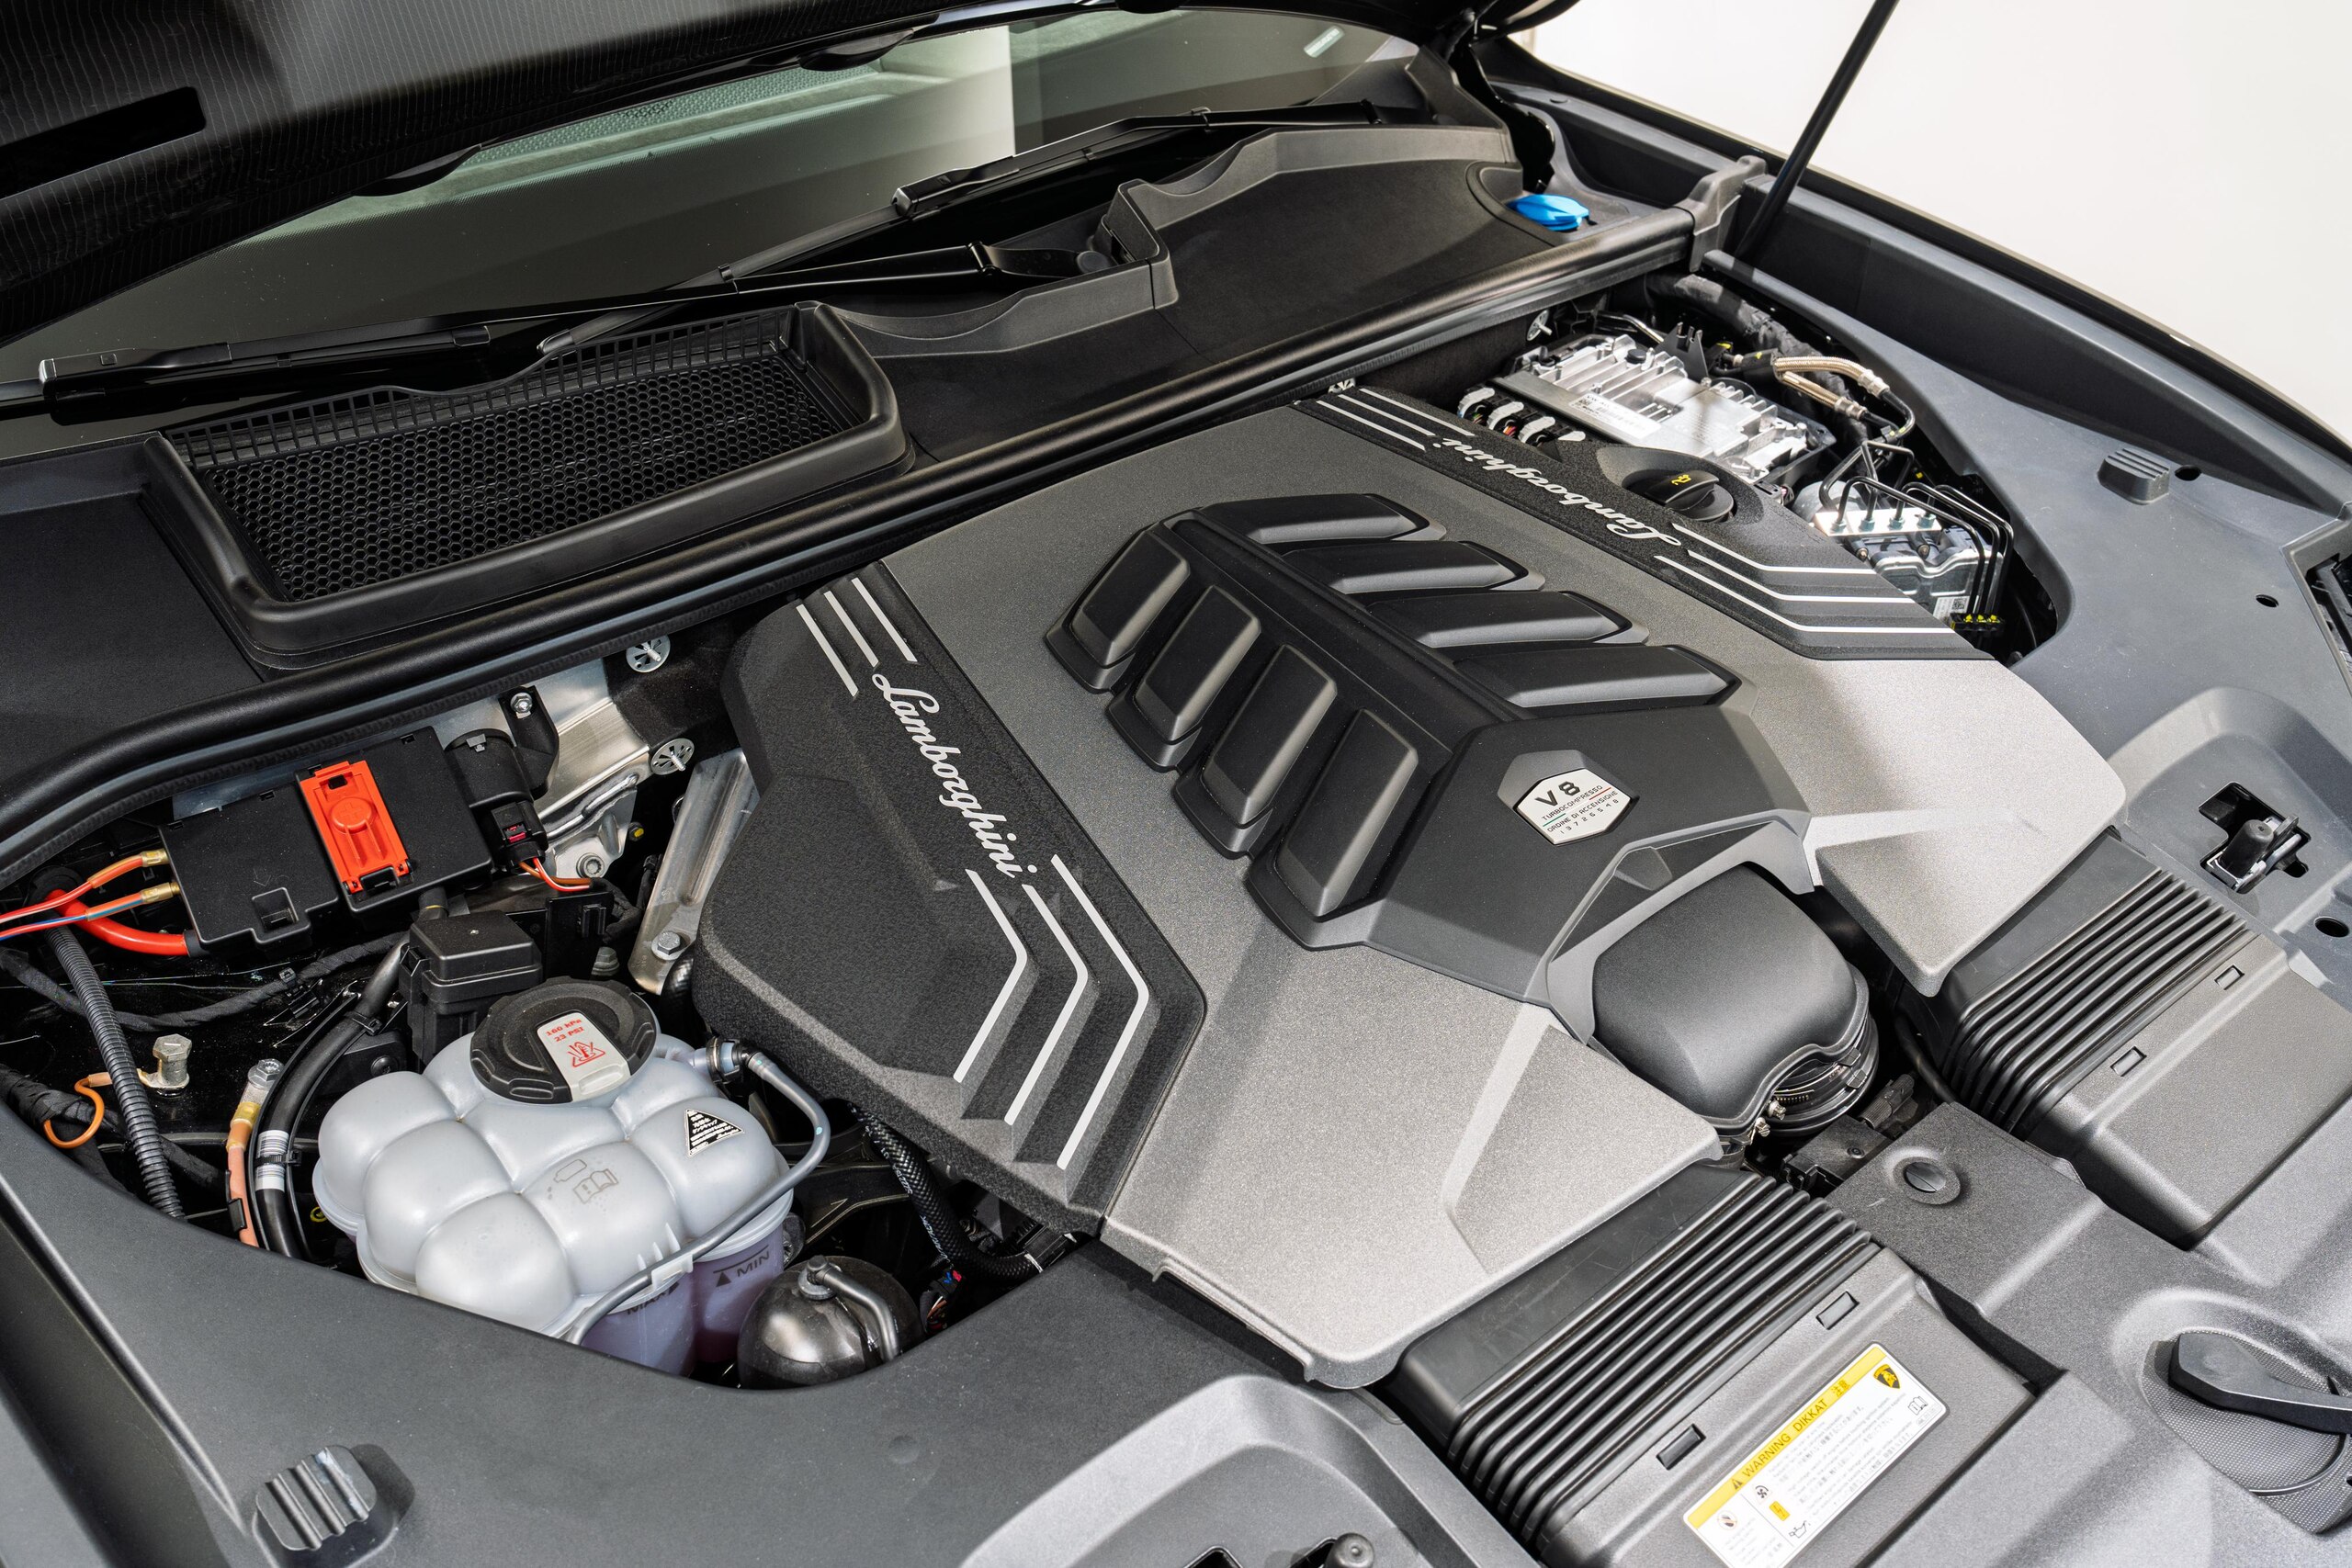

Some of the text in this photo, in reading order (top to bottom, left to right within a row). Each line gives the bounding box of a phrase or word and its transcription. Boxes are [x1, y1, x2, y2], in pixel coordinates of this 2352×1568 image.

[1433, 437, 1681, 547] Lamborghini
[872, 673, 1037, 879] Lamborghini
[1534, 781, 1581, 807] V8
[1541, 784, 1603, 821] TURBOCOMPRESSO
[1546, 790, 1618, 833] ORDINE DI ACCENSIONE
[554, 1026, 584, 1042] 23 PSI
[737, 1251, 770, 1278] MIN
[1742, 1432, 1791, 1478] WARNING
[1792, 1398, 1828, 1432] DIKKAT
